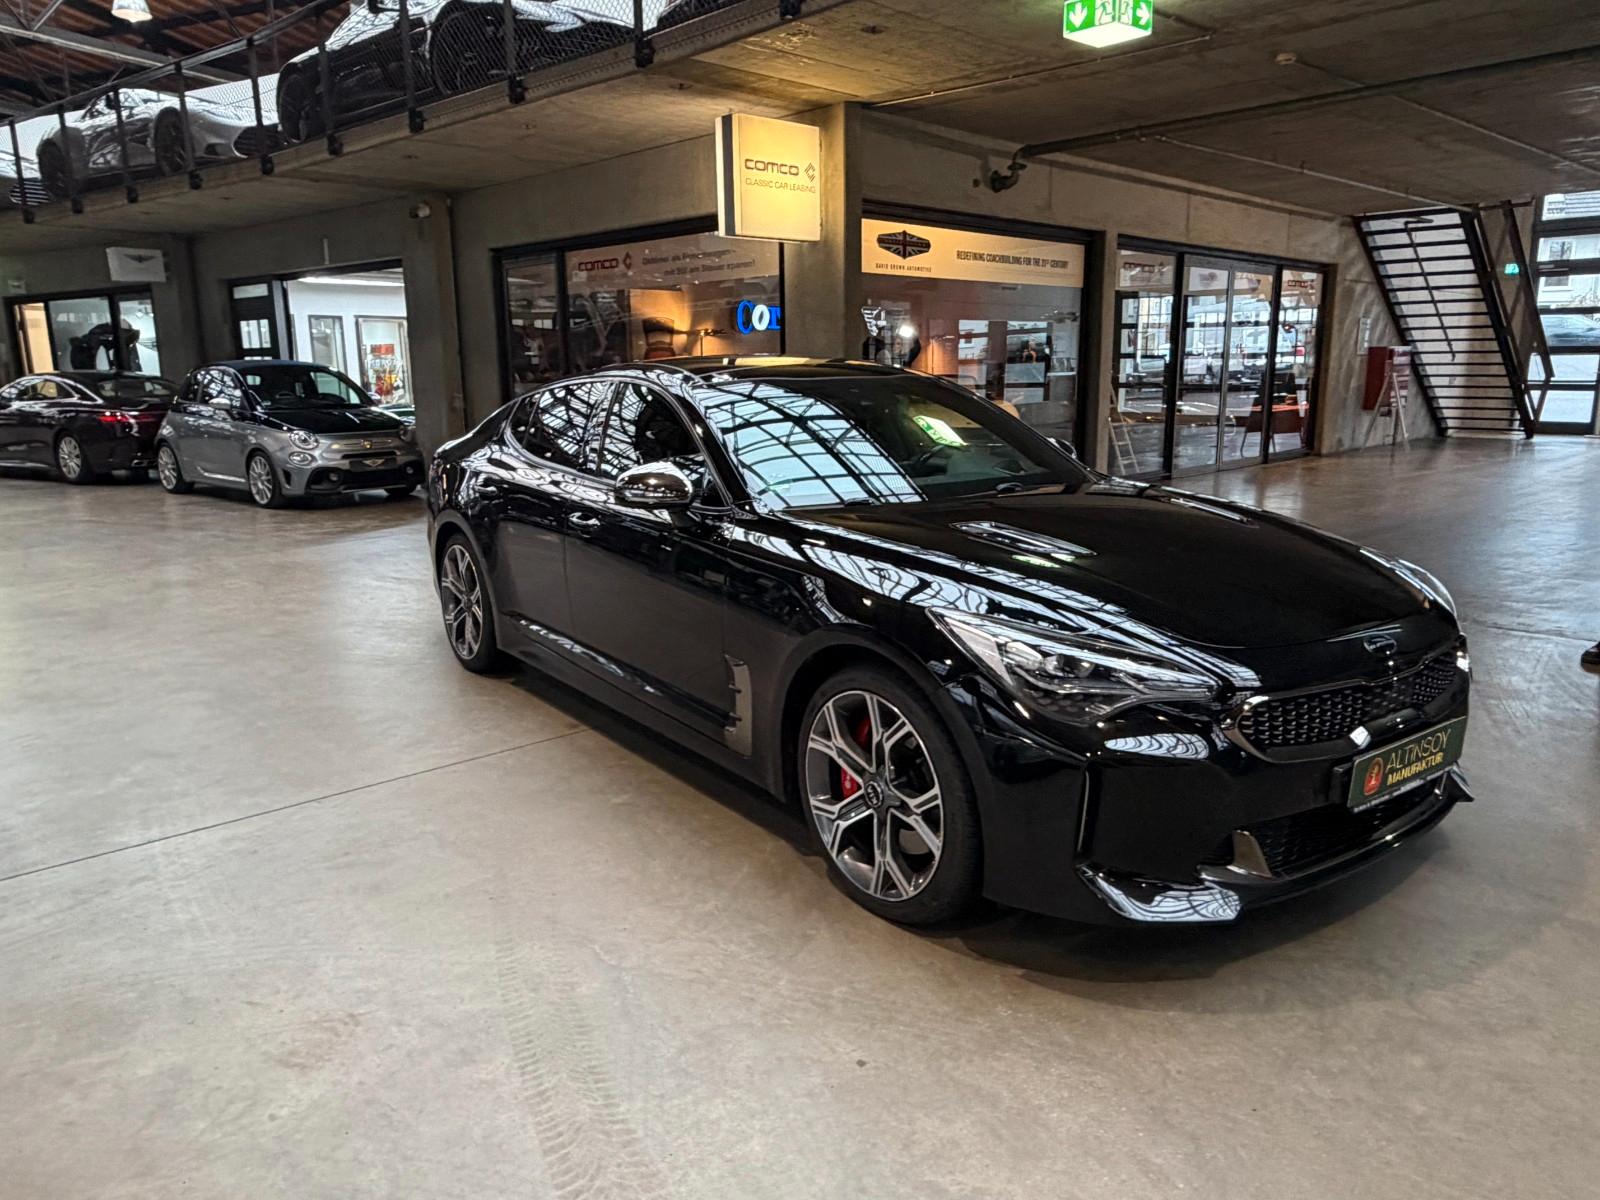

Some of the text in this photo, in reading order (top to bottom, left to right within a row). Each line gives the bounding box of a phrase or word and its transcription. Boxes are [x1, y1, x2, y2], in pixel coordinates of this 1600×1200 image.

[745, 177, 816, 194] CLASSIC CAR LEASING
[956, 250, 985, 262] REDEFINING
[1023, 256, 1032, 266] FOR
[1387, 752, 1444, 786] MANUFAKTUR
